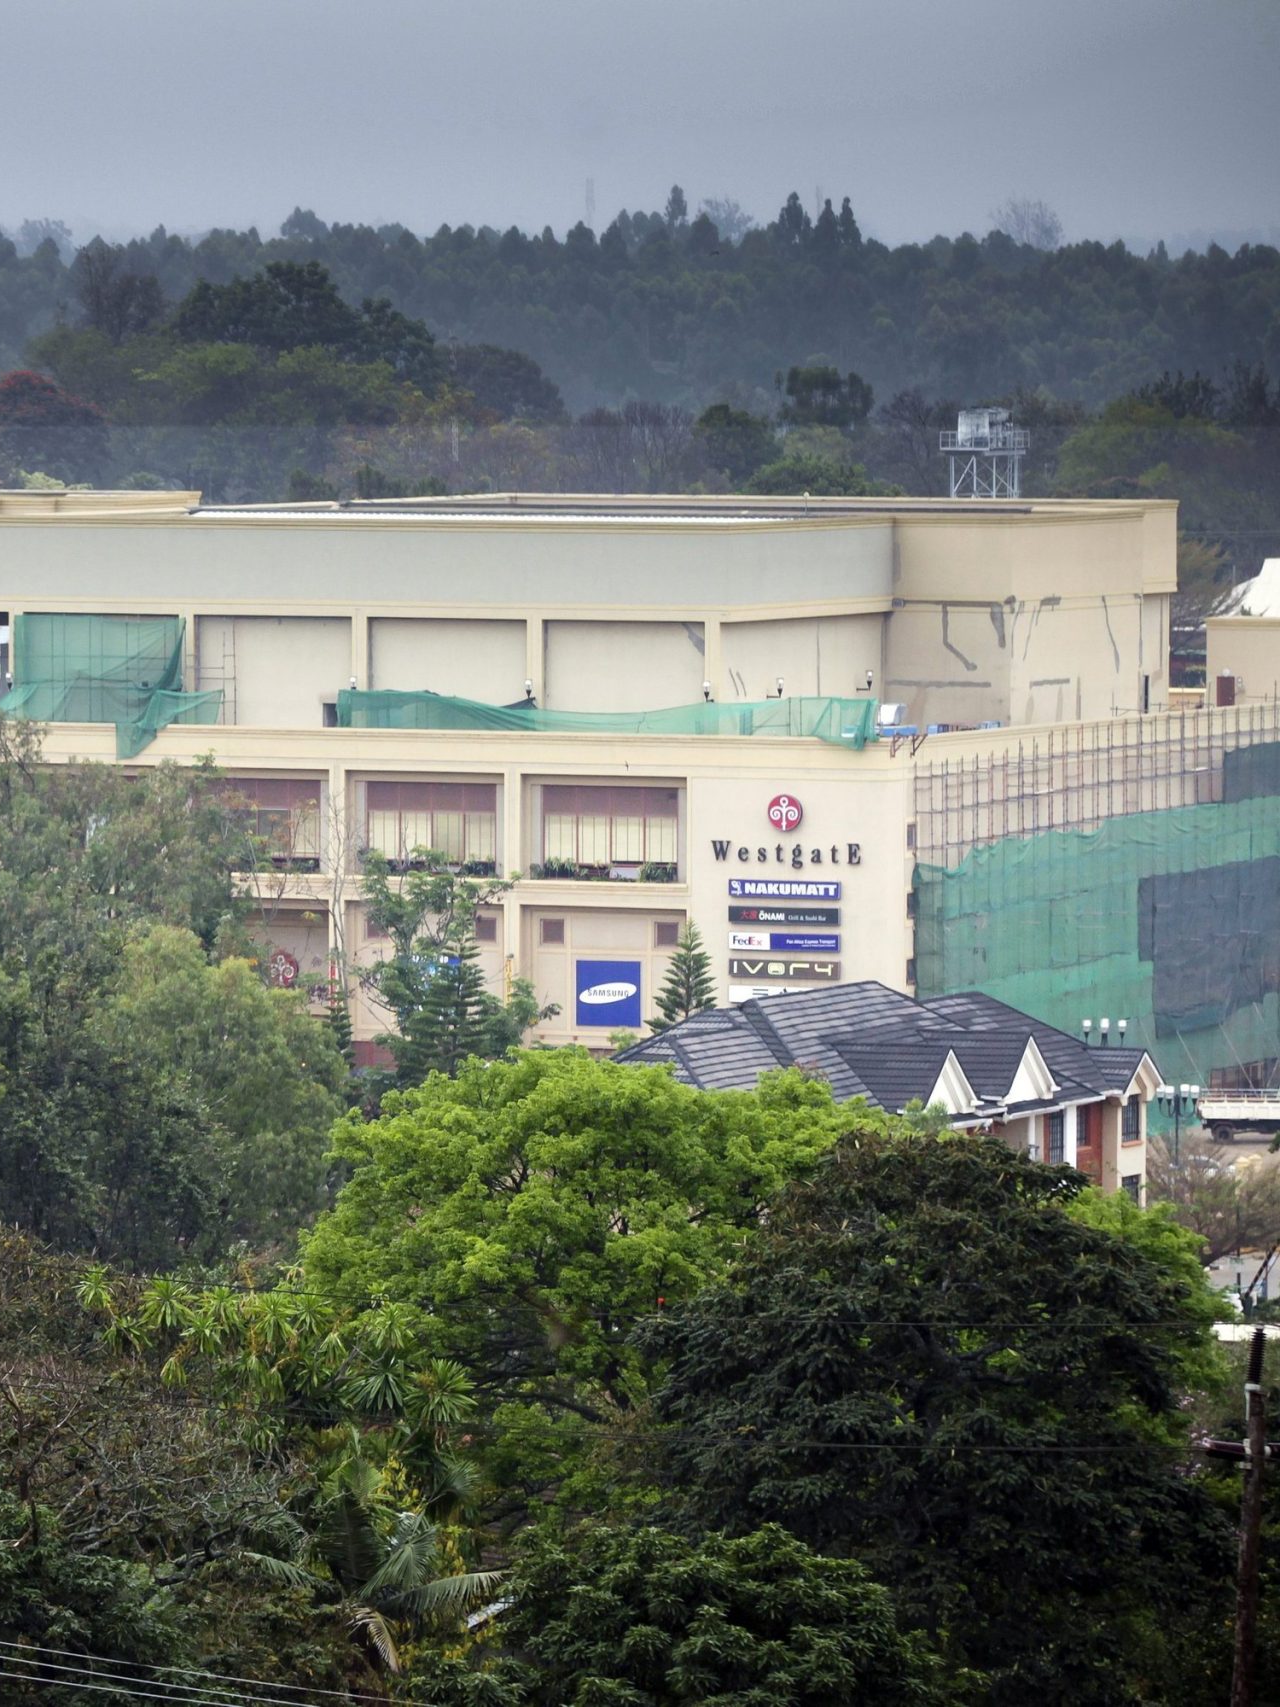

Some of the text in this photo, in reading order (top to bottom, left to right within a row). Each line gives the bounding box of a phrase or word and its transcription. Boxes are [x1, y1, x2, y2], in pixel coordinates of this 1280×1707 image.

[745, 882, 837, 896] NAKUMATT
[733, 935, 762, 945] FedEx
[587, 989, 630, 999] SAMSUNG
